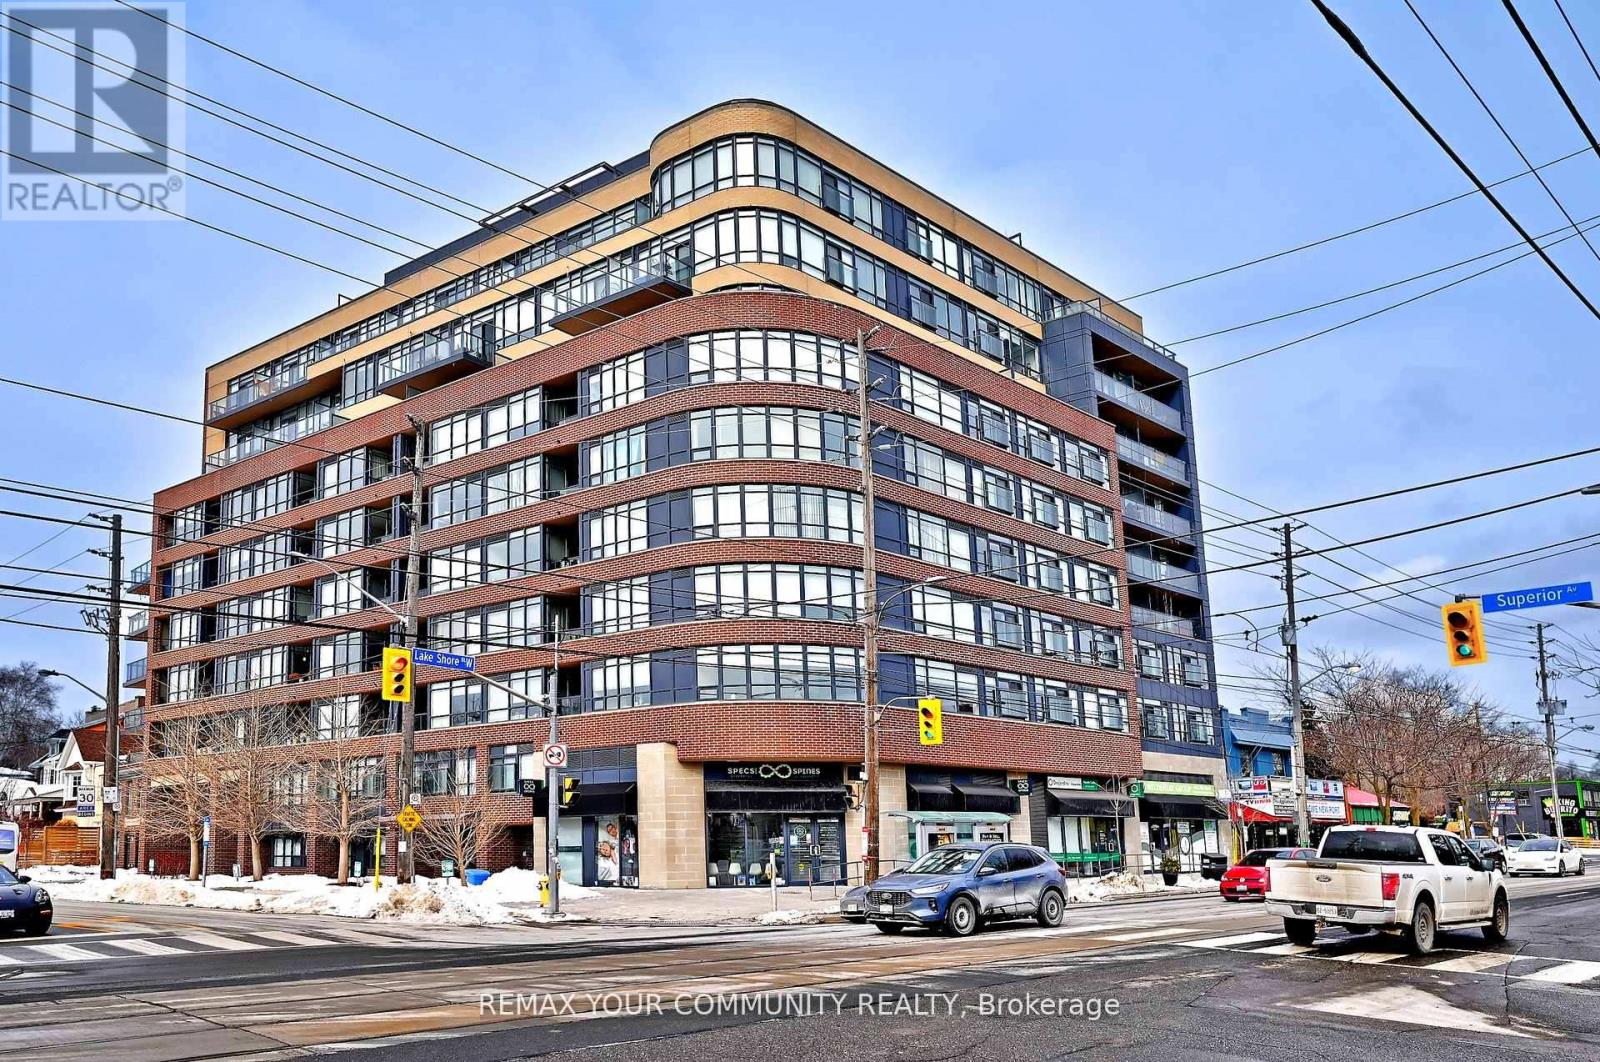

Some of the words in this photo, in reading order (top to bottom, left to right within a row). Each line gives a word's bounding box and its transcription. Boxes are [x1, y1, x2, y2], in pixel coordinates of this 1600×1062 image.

[1497, 588, 1562, 607] Superior
[414, 649, 433, 662] Lake
[436, 653, 460, 666] Shore
[79, 793, 94, 802] 30
[1543, 804, 1579, 816] BURITO
